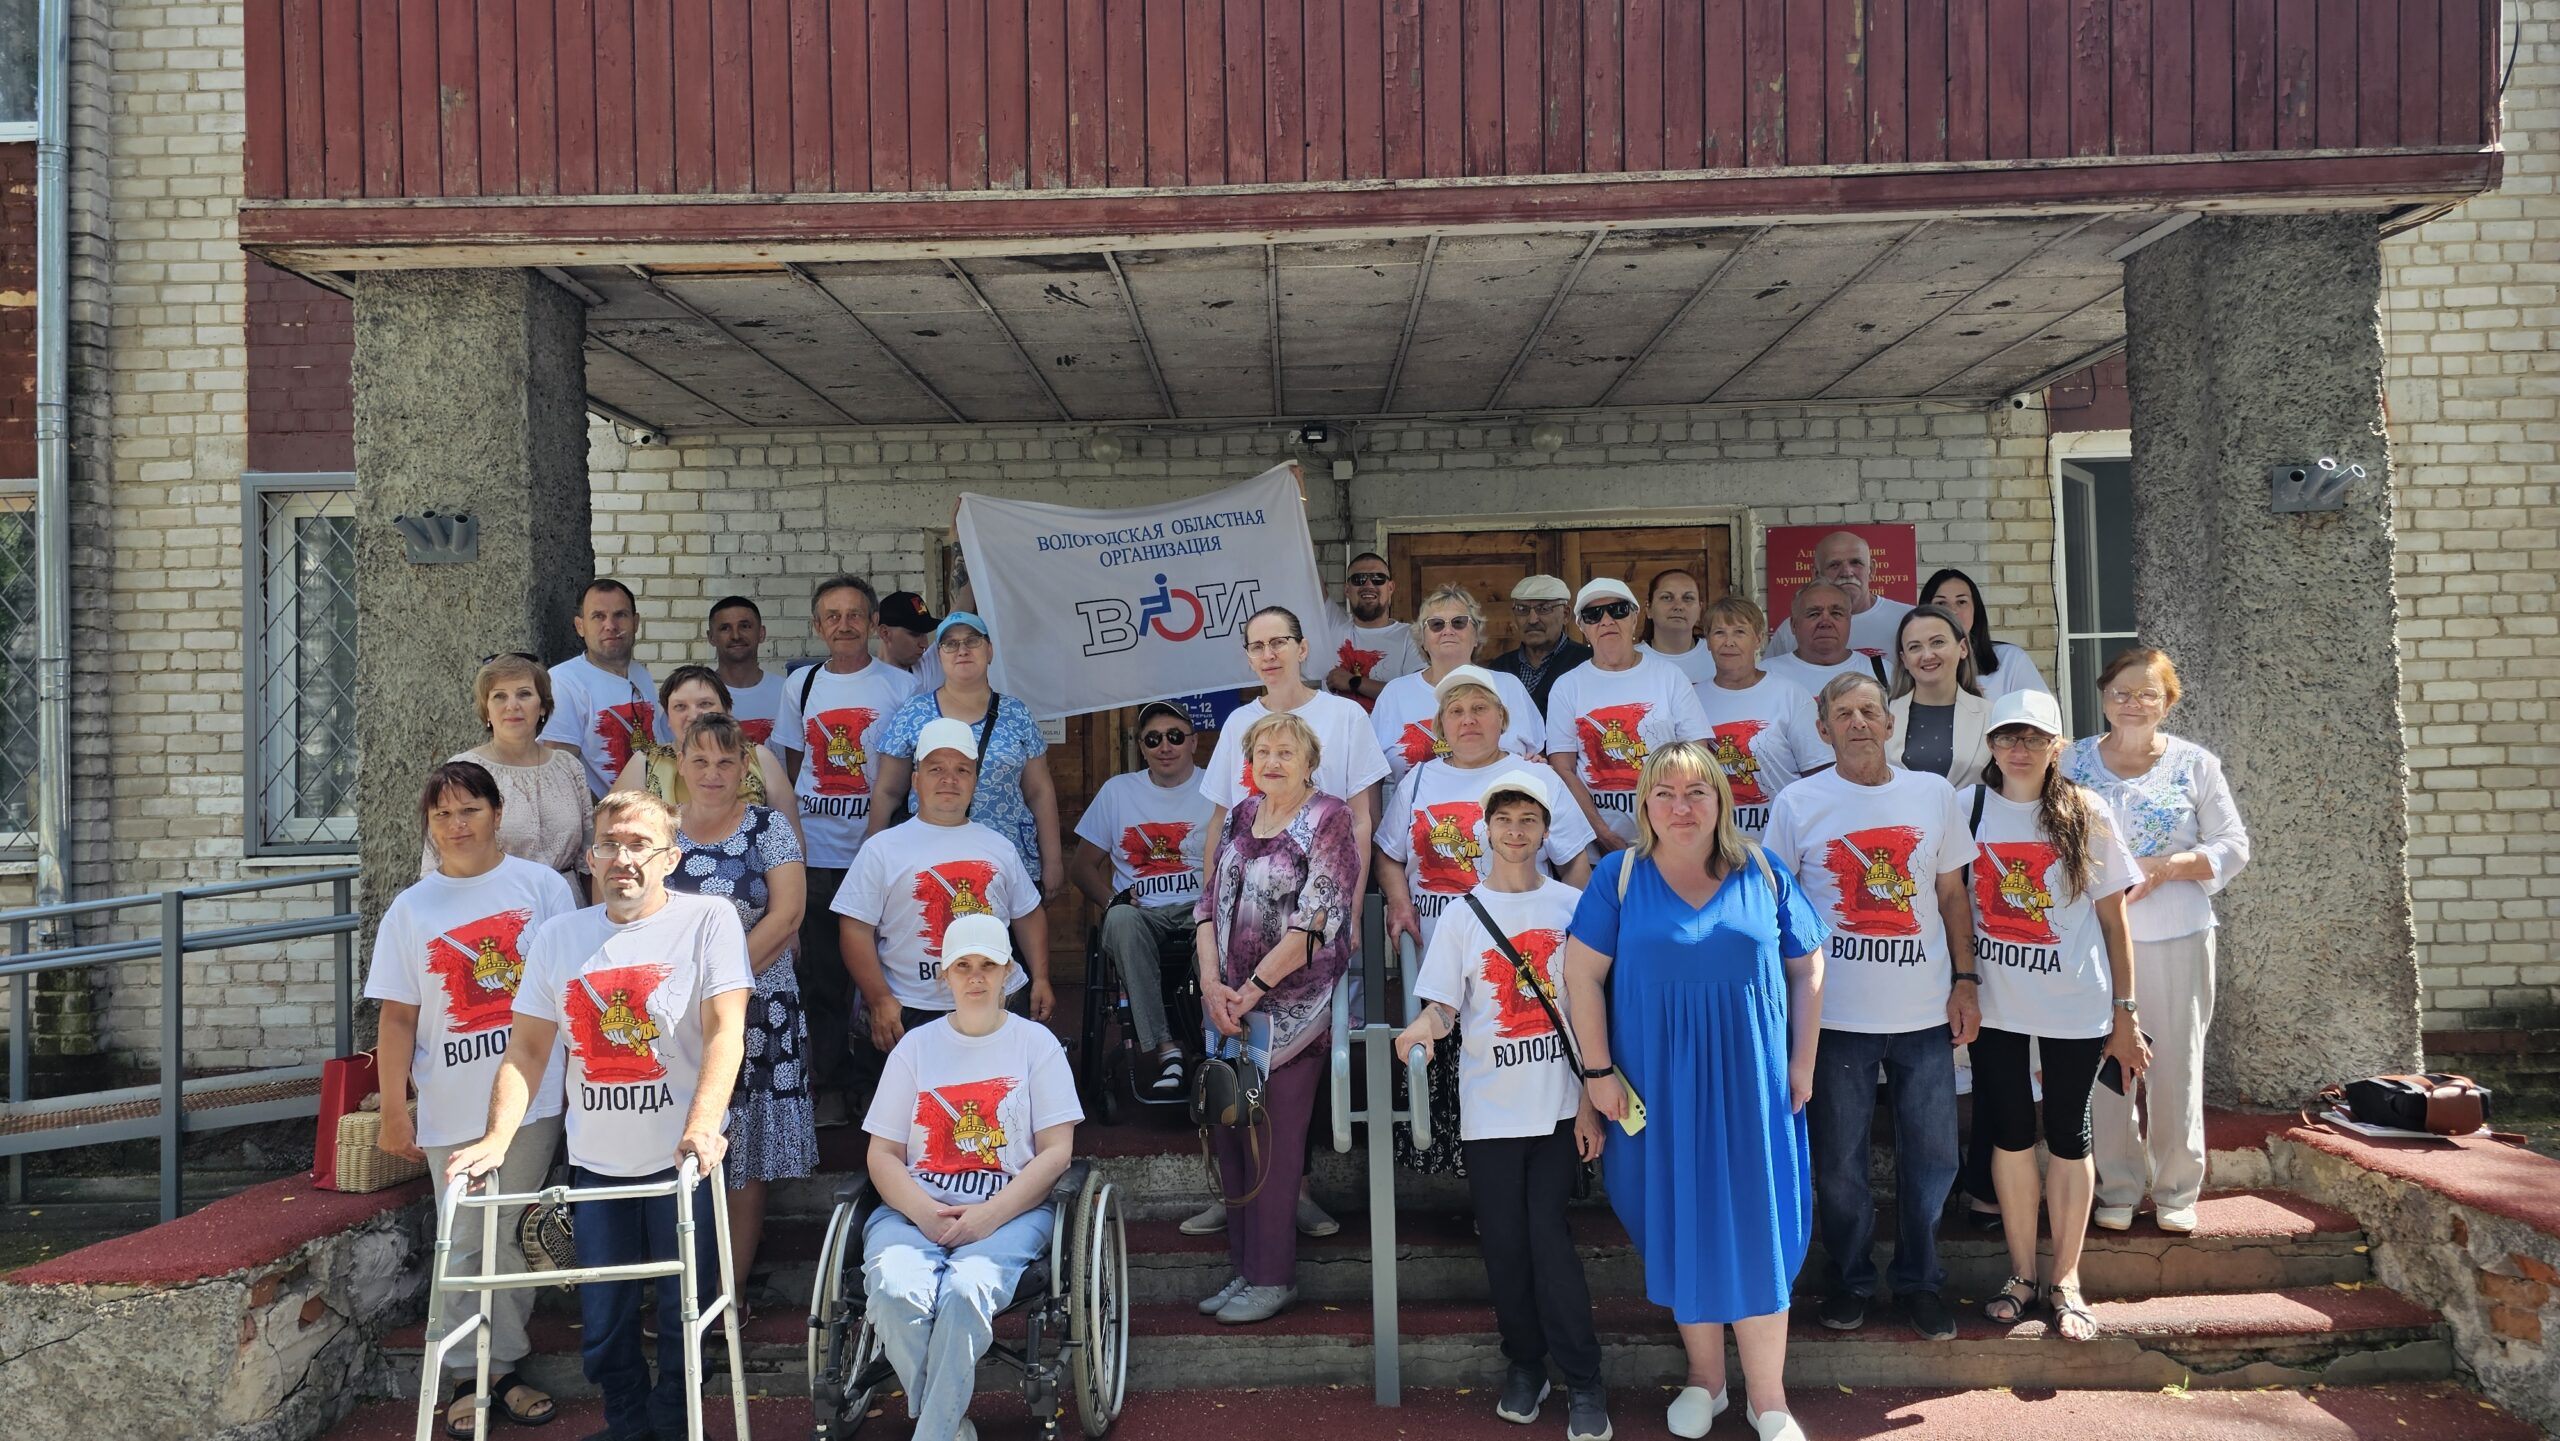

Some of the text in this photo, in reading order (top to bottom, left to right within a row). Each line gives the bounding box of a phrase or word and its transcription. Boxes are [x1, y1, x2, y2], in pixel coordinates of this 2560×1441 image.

[1037, 509, 1265, 551] ВОЛОГОДСКАЯ ОБЛАСТНАЯ
[1100, 535, 1222, 567] ОРГАНИЗАЦИЯ
[1831, 935, 1927, 967] ВОЛОГДА
[1493, 1034, 1567, 1068] ВОЛОГД
[580, 1082, 674, 1114] ОЛОГДА
